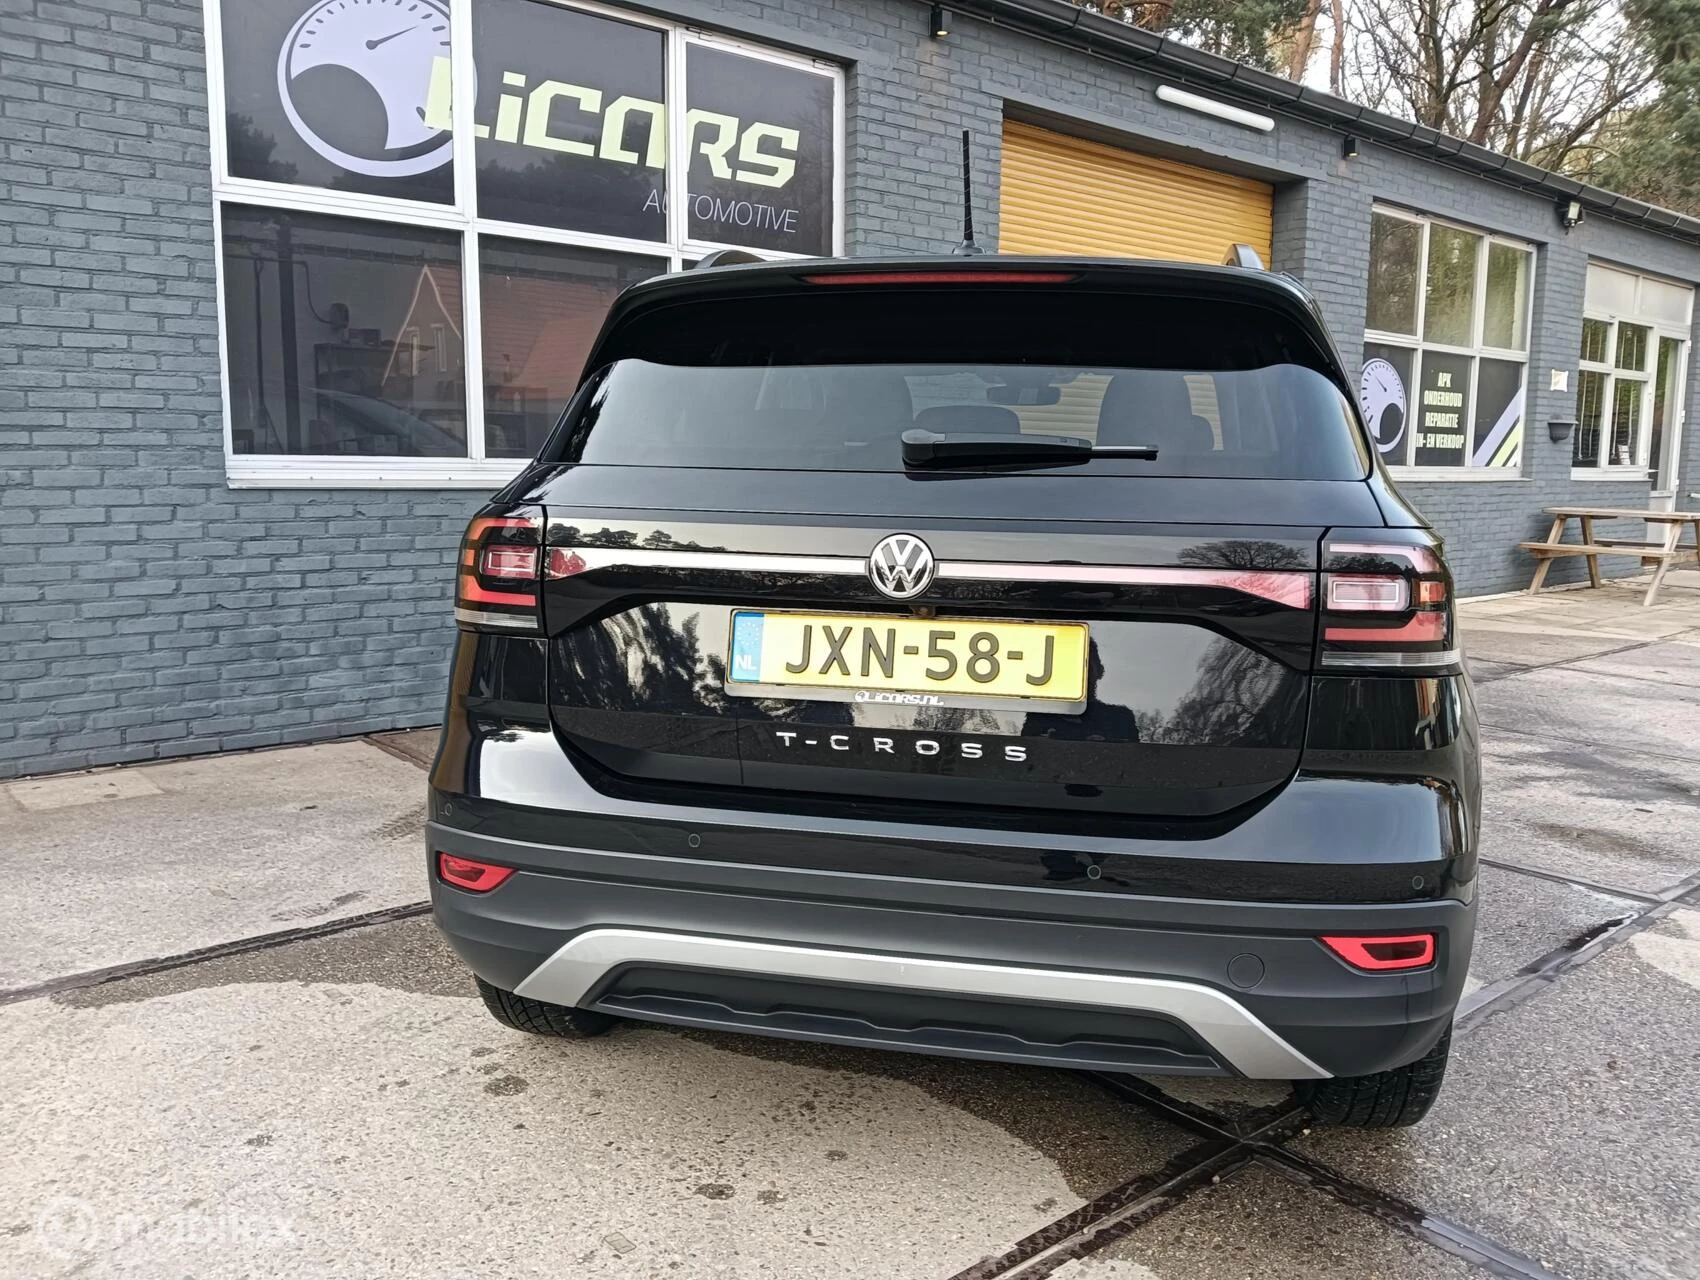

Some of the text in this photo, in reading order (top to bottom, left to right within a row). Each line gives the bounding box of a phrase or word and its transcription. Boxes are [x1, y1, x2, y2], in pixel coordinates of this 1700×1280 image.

[1437, 371, 1452, 388] APK
[1423, 390, 1463, 408] ONDERHOUD
[1424, 411, 1459, 428] REPARATIE
[1435, 433, 1465, 449] VERKOOP
[734, 653, 757, 671] NL
[785, 624, 1055, 687] JXN-58-J
[775, 730, 1028, 762] T-CROSS
